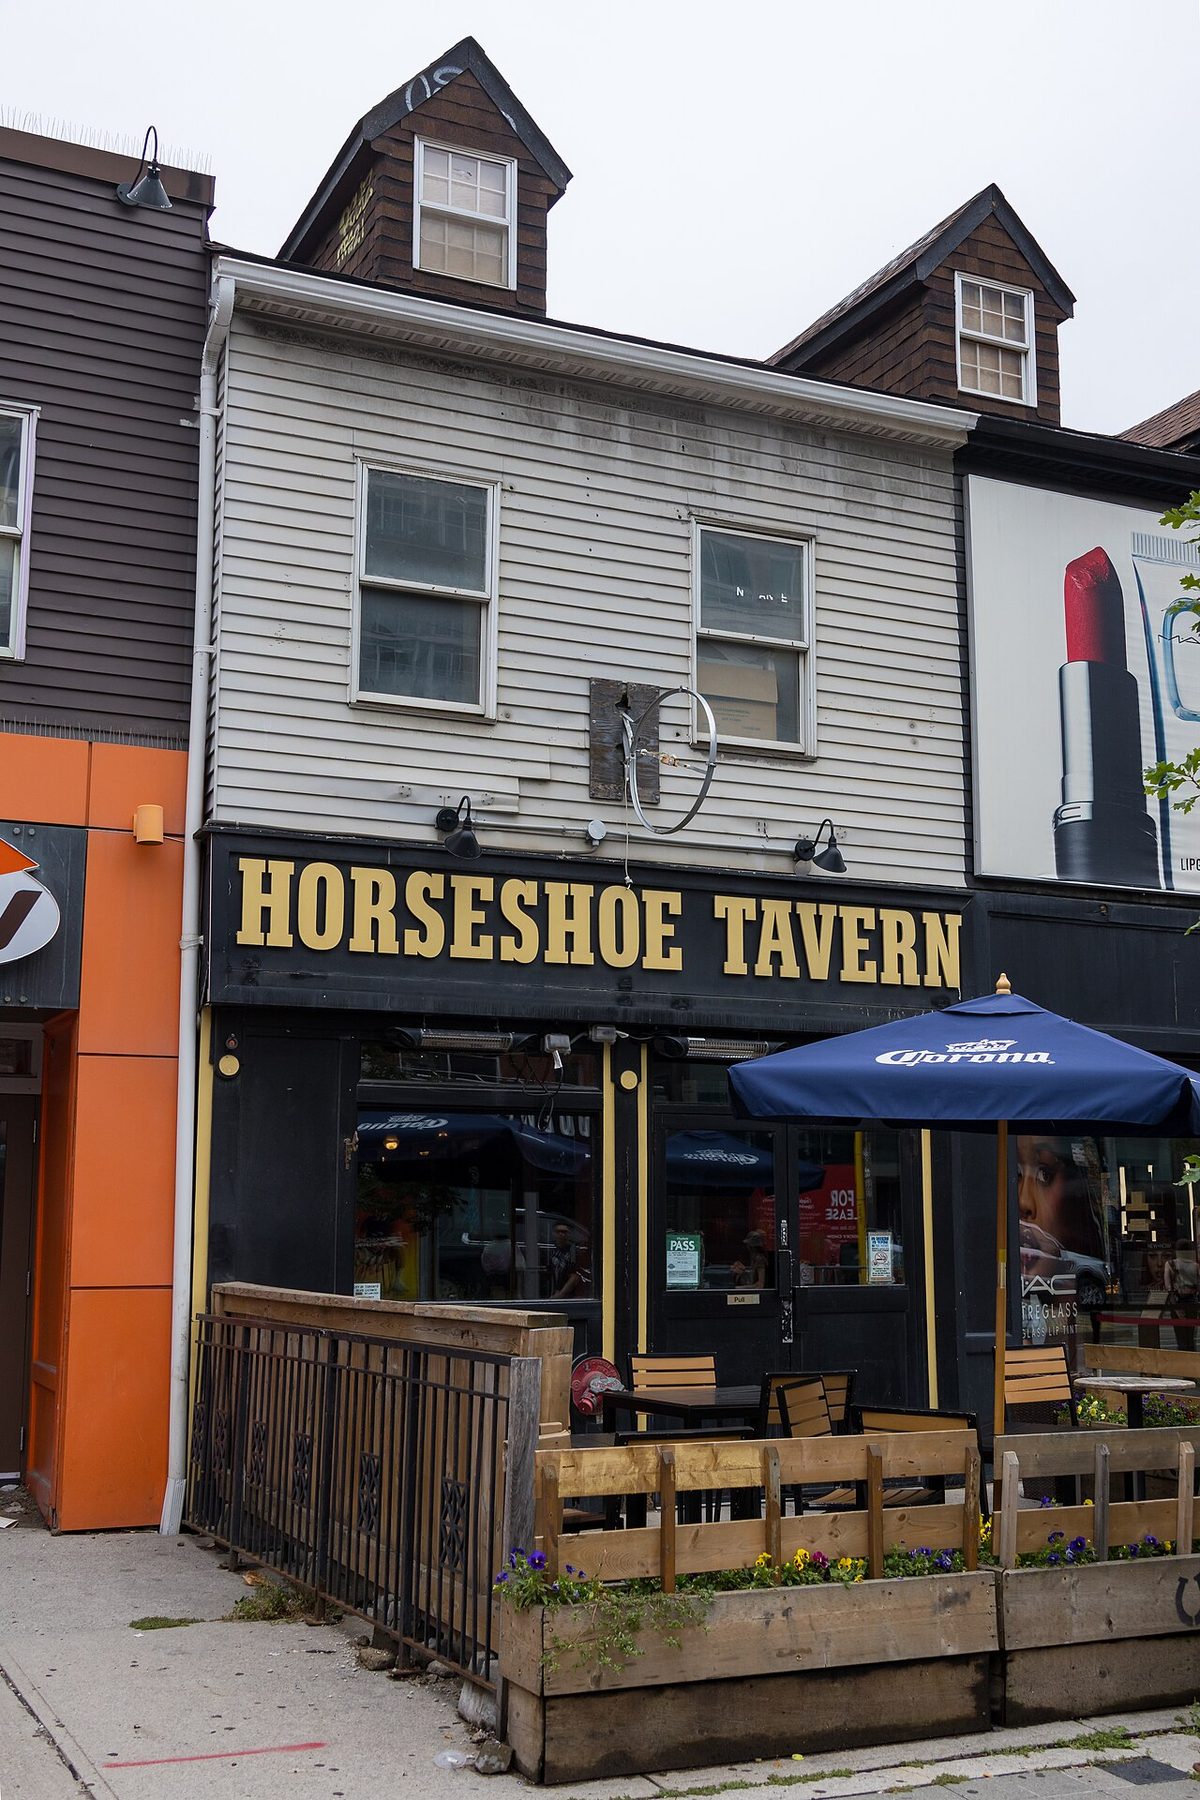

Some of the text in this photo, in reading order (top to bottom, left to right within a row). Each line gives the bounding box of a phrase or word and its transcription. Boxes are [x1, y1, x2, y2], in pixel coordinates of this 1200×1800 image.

[236, 858, 962, 989] HORSESHOE TAVERN
[875, 1049, 1051, 1067] Corona
[670, 1240, 695, 1251] PASS
[1048, 1325, 1060, 1336] LIP
[1063, 1324, 1078, 1335] TINT
